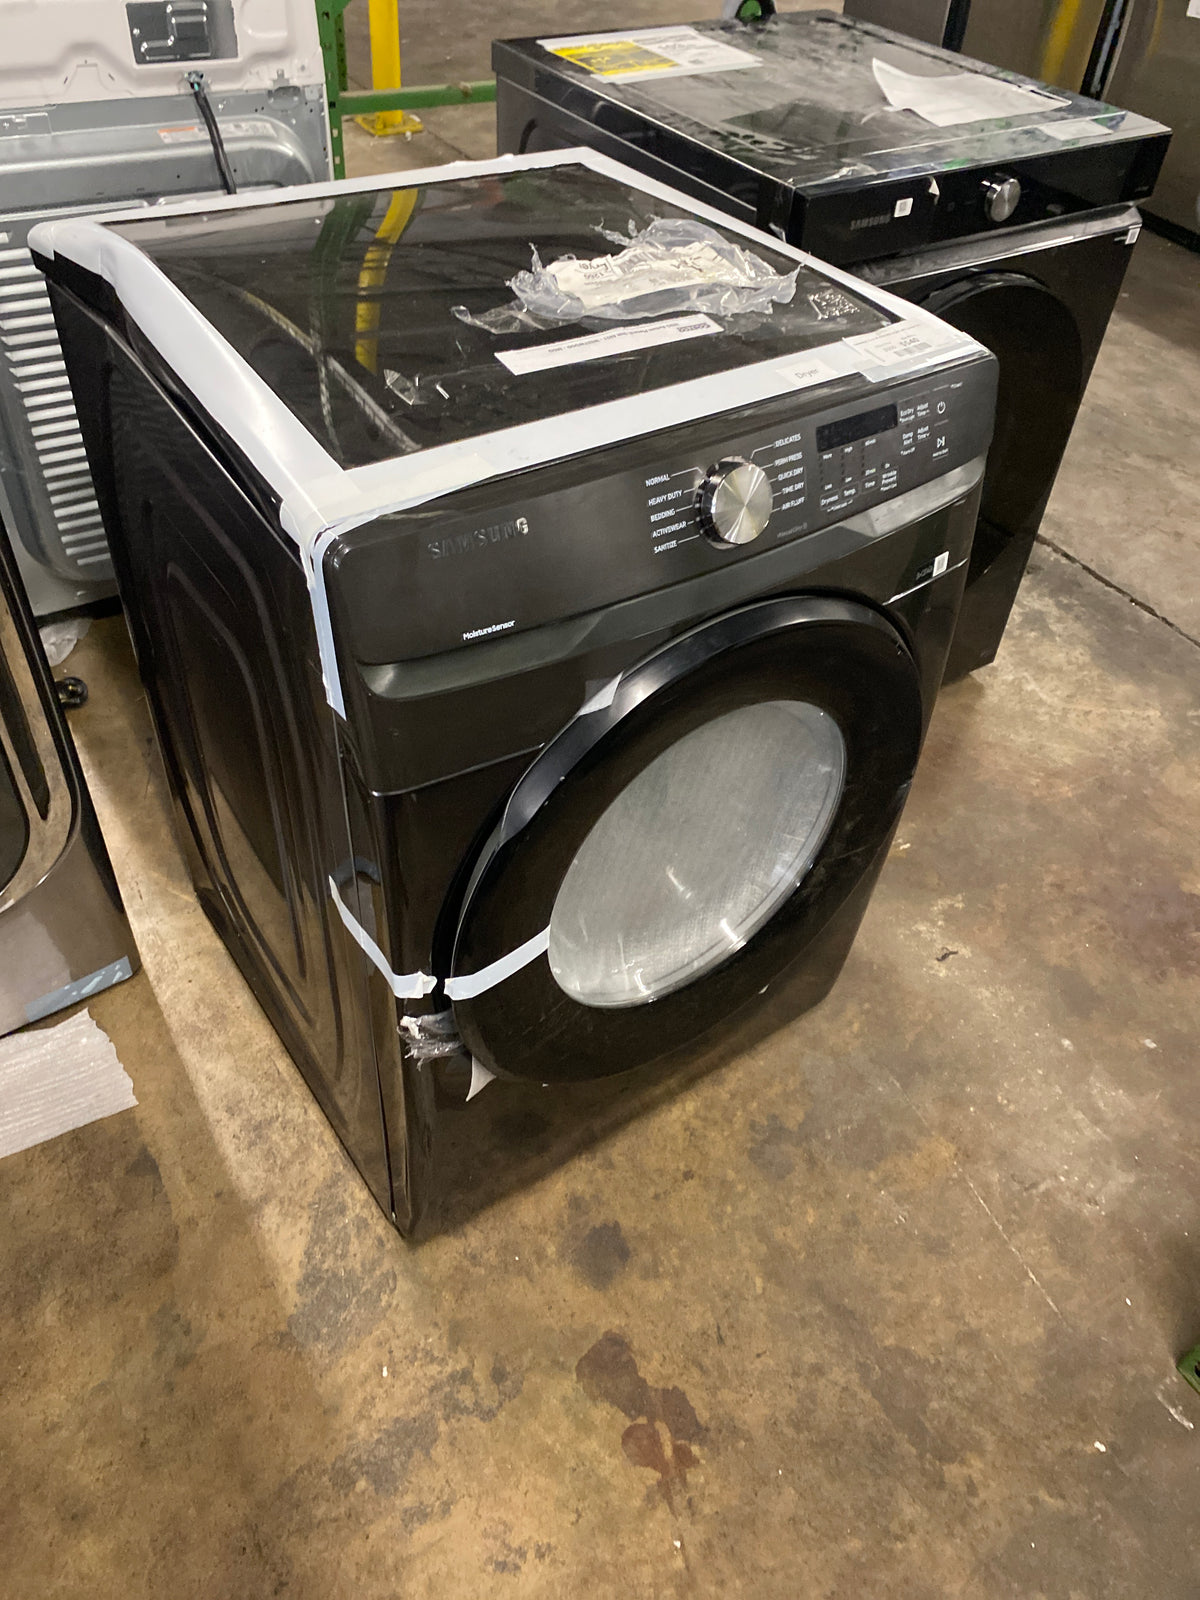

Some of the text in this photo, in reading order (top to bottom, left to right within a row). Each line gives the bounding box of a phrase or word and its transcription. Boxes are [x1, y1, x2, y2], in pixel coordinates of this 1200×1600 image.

[850, 213, 891, 231] SAMSUNG
[774, 433, 801, 448] DELICATES
[645, 474, 671, 487] NORMAL
[778, 466, 804, 481] QUICK DRY
[782, 481, 805, 495] TIME DRY
[648, 489, 683, 507] HEAVY DUTY
[781, 502, 791, 511] AIR
[650, 508, 676, 523] BEDDING
[427, 517, 529, 560] SAMSUNG
[653, 539, 678, 554] SANITIZE
[462, 620, 516, 641] Moisture Sensor
